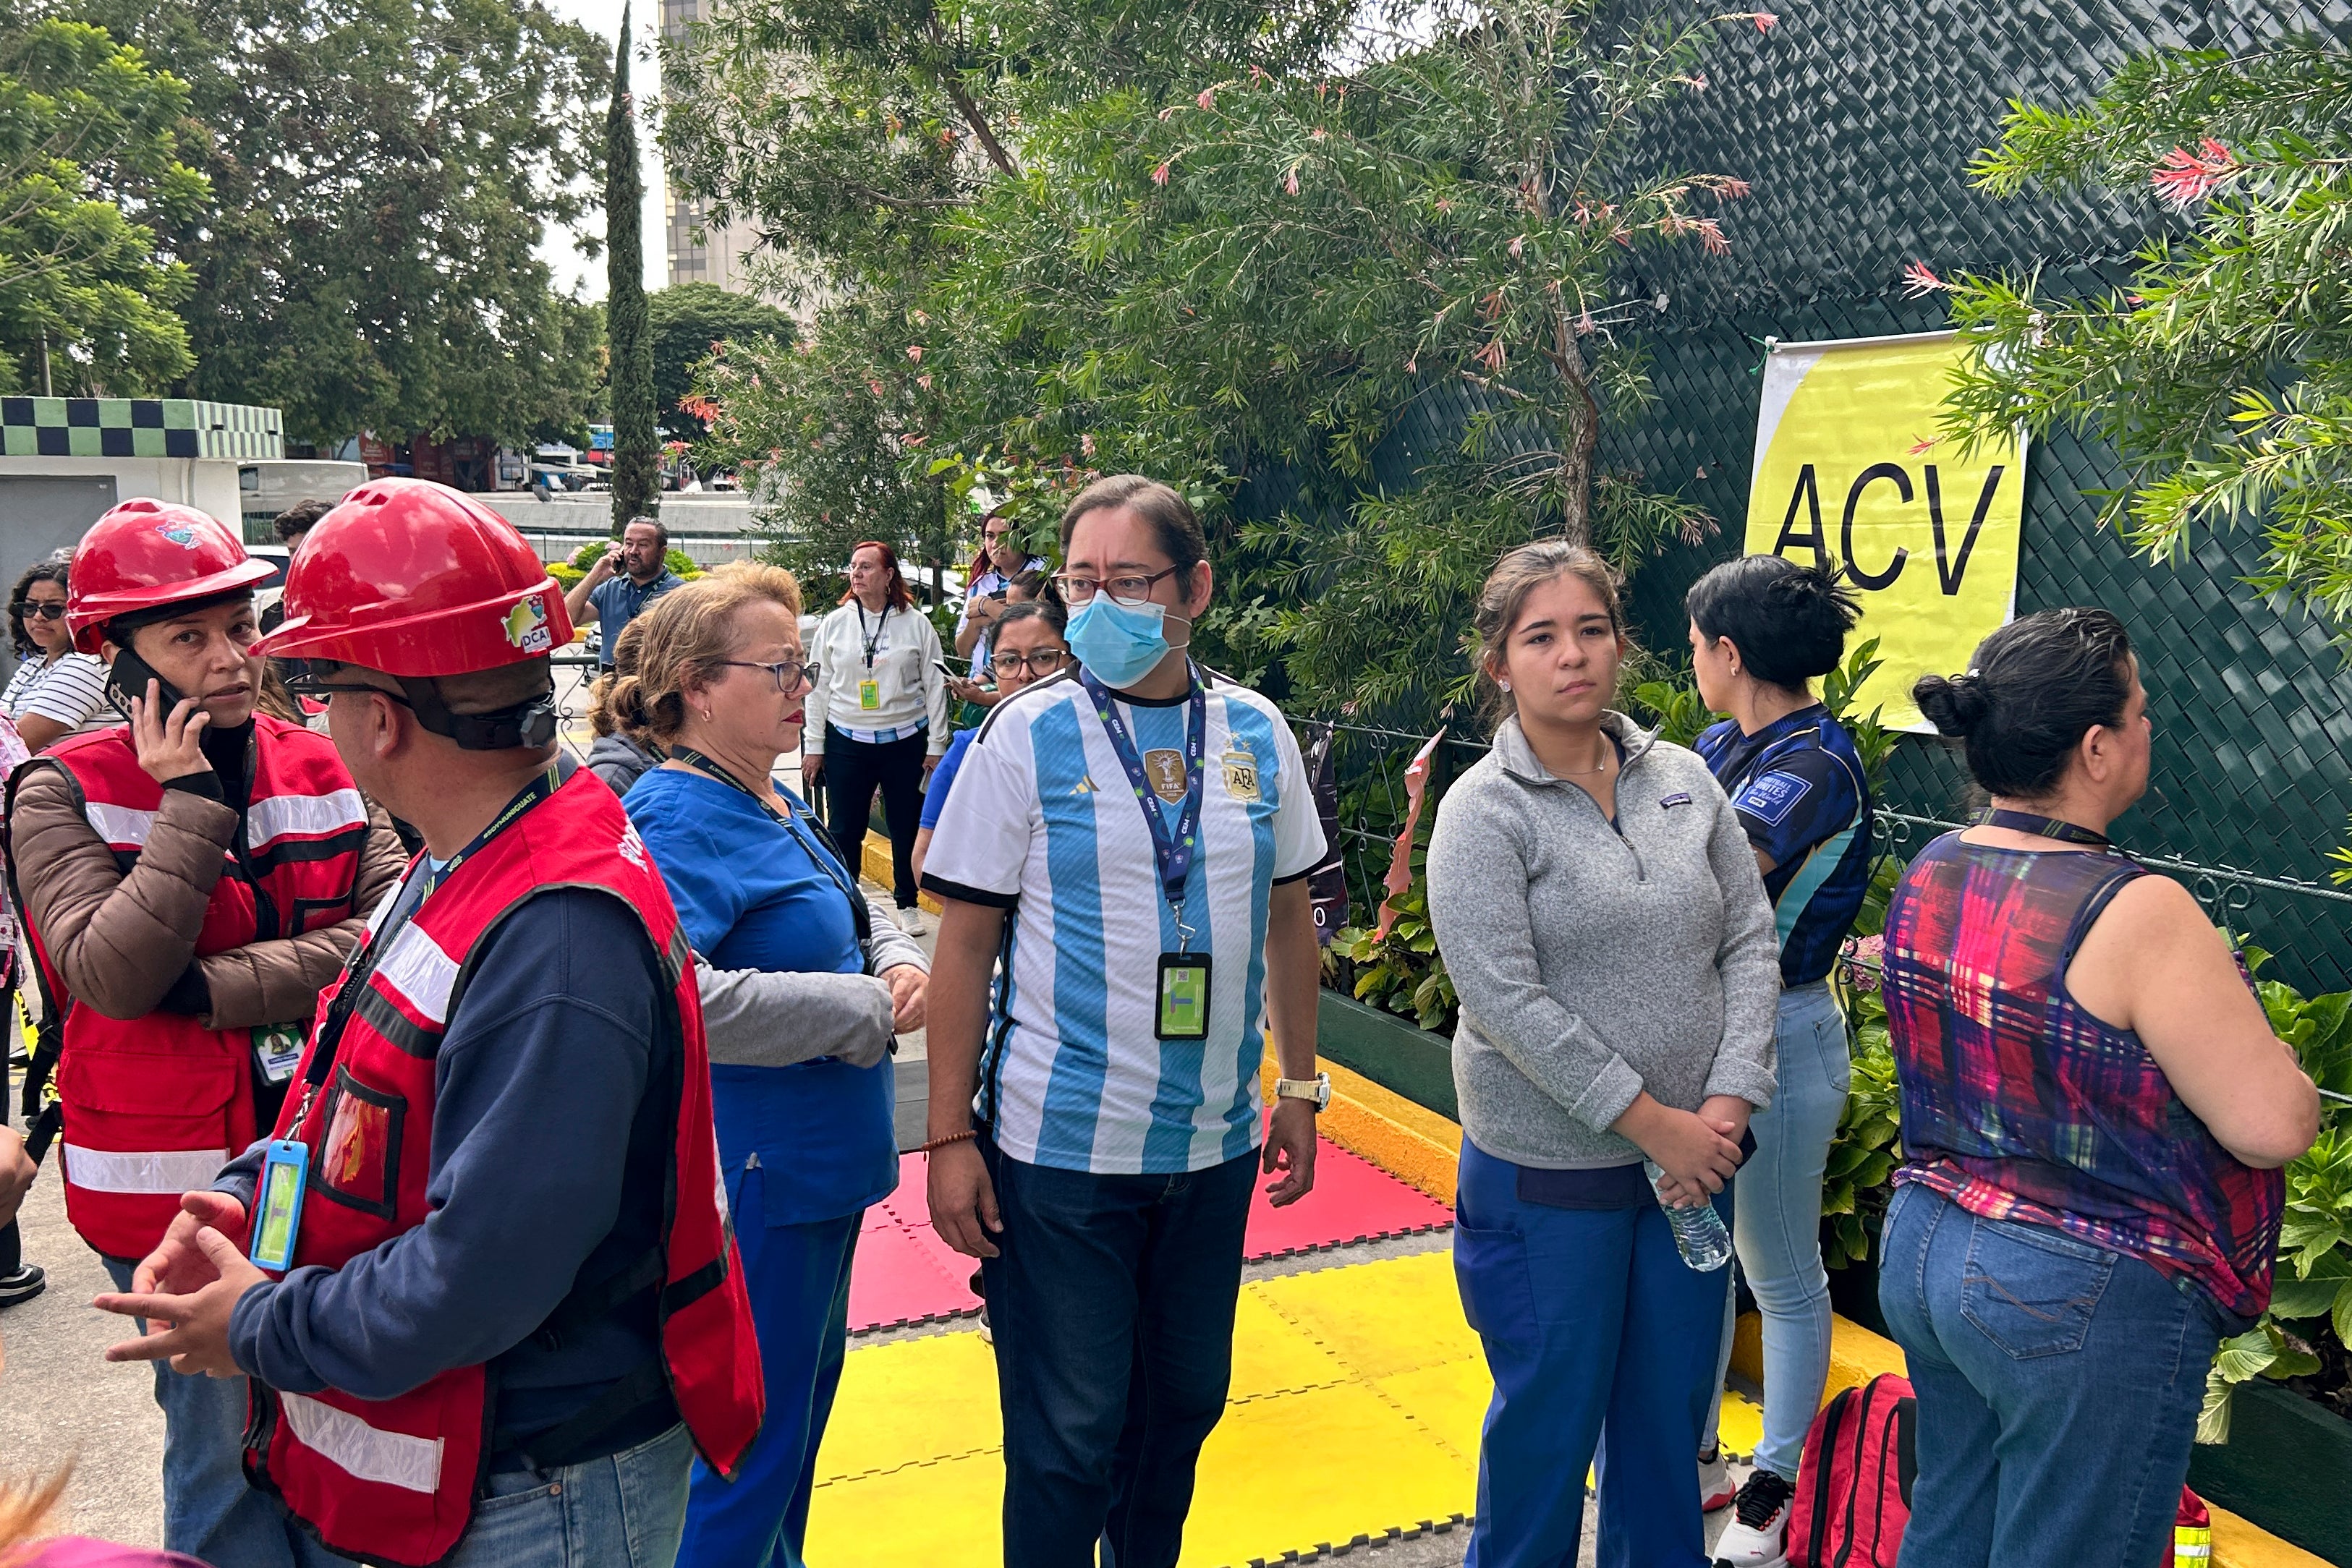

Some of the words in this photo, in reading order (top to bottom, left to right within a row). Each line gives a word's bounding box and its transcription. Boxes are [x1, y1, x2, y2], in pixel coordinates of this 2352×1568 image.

[1772, 462, 2005, 597] ACV
[522, 629, 549, 646] DCAI
[1233, 766, 1255, 790] AFA
[1755, 781, 1788, 798] UNITES
[483, 792, 537, 839] #SOYMUNIGUATE
